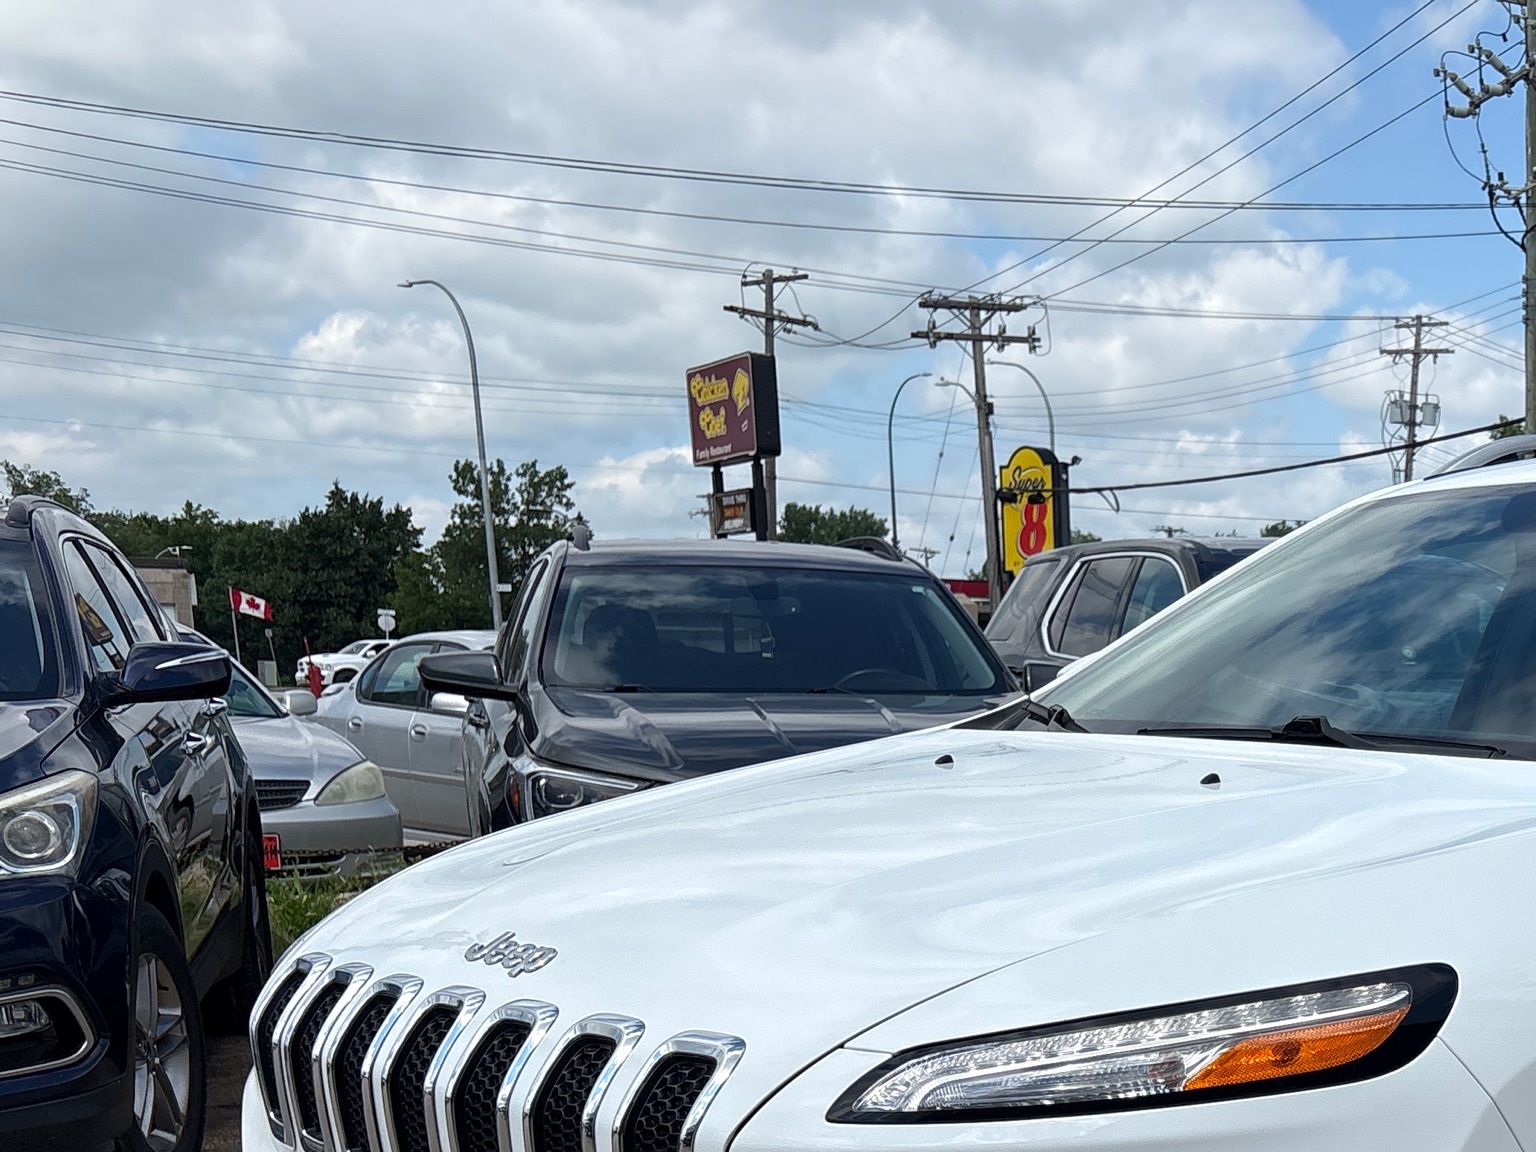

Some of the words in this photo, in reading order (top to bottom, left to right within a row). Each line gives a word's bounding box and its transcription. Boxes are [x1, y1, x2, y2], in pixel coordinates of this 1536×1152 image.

[690, 373, 729, 407] Chicken
[699, 406, 727, 439] Chef
[696, 447, 710, 460] Family
[710, 442, 732, 457] Restaurant
[1009, 465, 1047, 502] Super
[1018, 499, 1048, 558] 8
[464, 931, 558, 978] Jeep
